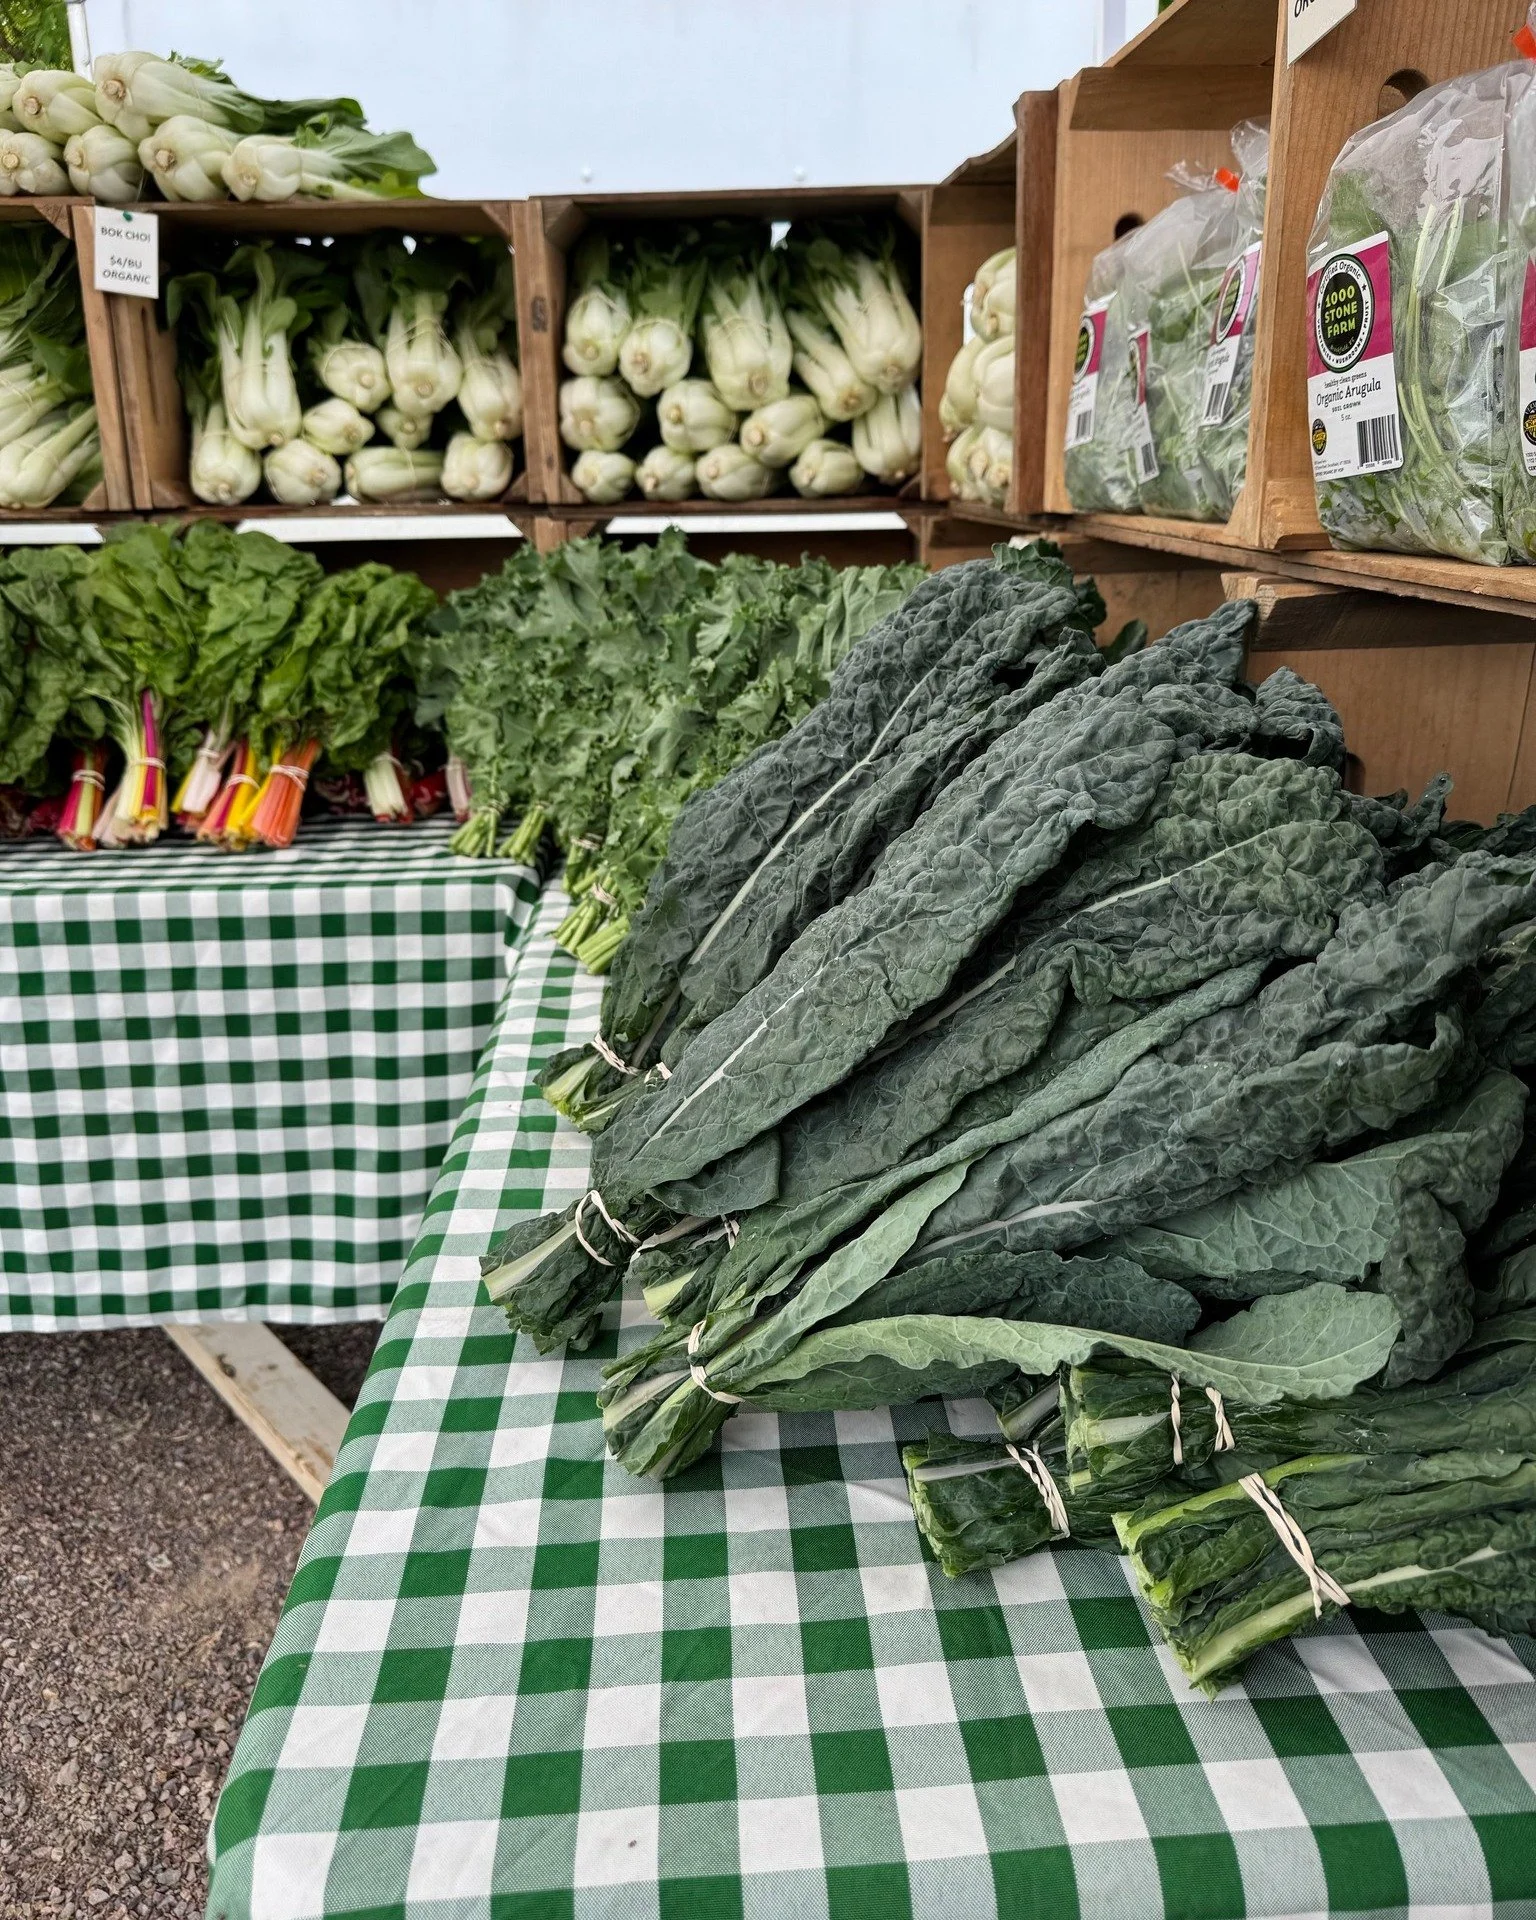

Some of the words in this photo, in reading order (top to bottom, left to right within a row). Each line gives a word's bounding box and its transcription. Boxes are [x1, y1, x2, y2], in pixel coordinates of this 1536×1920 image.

[101, 226, 123, 238] BOK
[125, 230, 151, 243] CHOI
[110, 255, 142, 269] $4/BU
[1339, 261, 1361, 280] Organic
[103, 270, 151, 284] ORGANIC
[1325, 285, 1356, 308] 1000
[1324, 301, 1358, 324] STONE
[1327, 317, 1356, 339] FARM
[1316, 387, 1344, 408] Organic
[1344, 377, 1381, 399] Arugula
